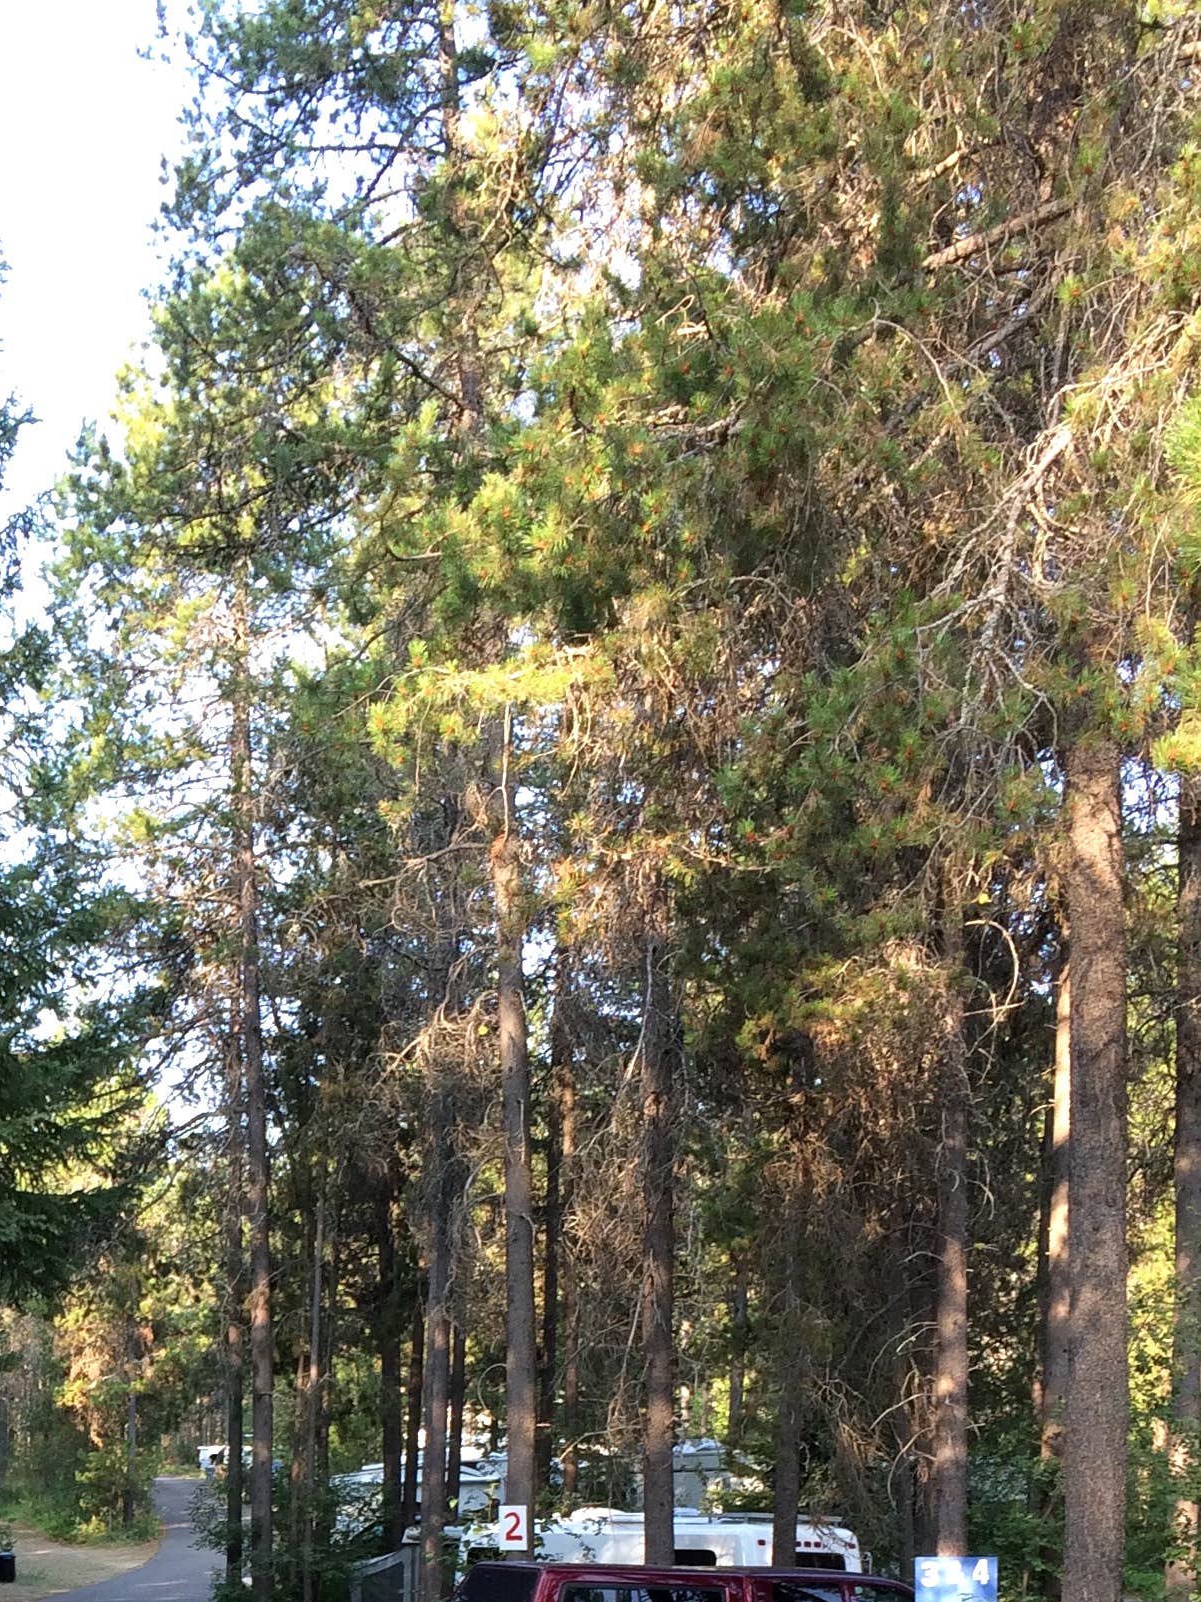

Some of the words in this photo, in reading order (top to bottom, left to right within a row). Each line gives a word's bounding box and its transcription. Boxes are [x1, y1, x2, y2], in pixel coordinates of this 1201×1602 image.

[504, 1512, 523, 1541] 2
[920, 1560, 939, 1588] 3
[972, 1558, 990, 1585] 4
